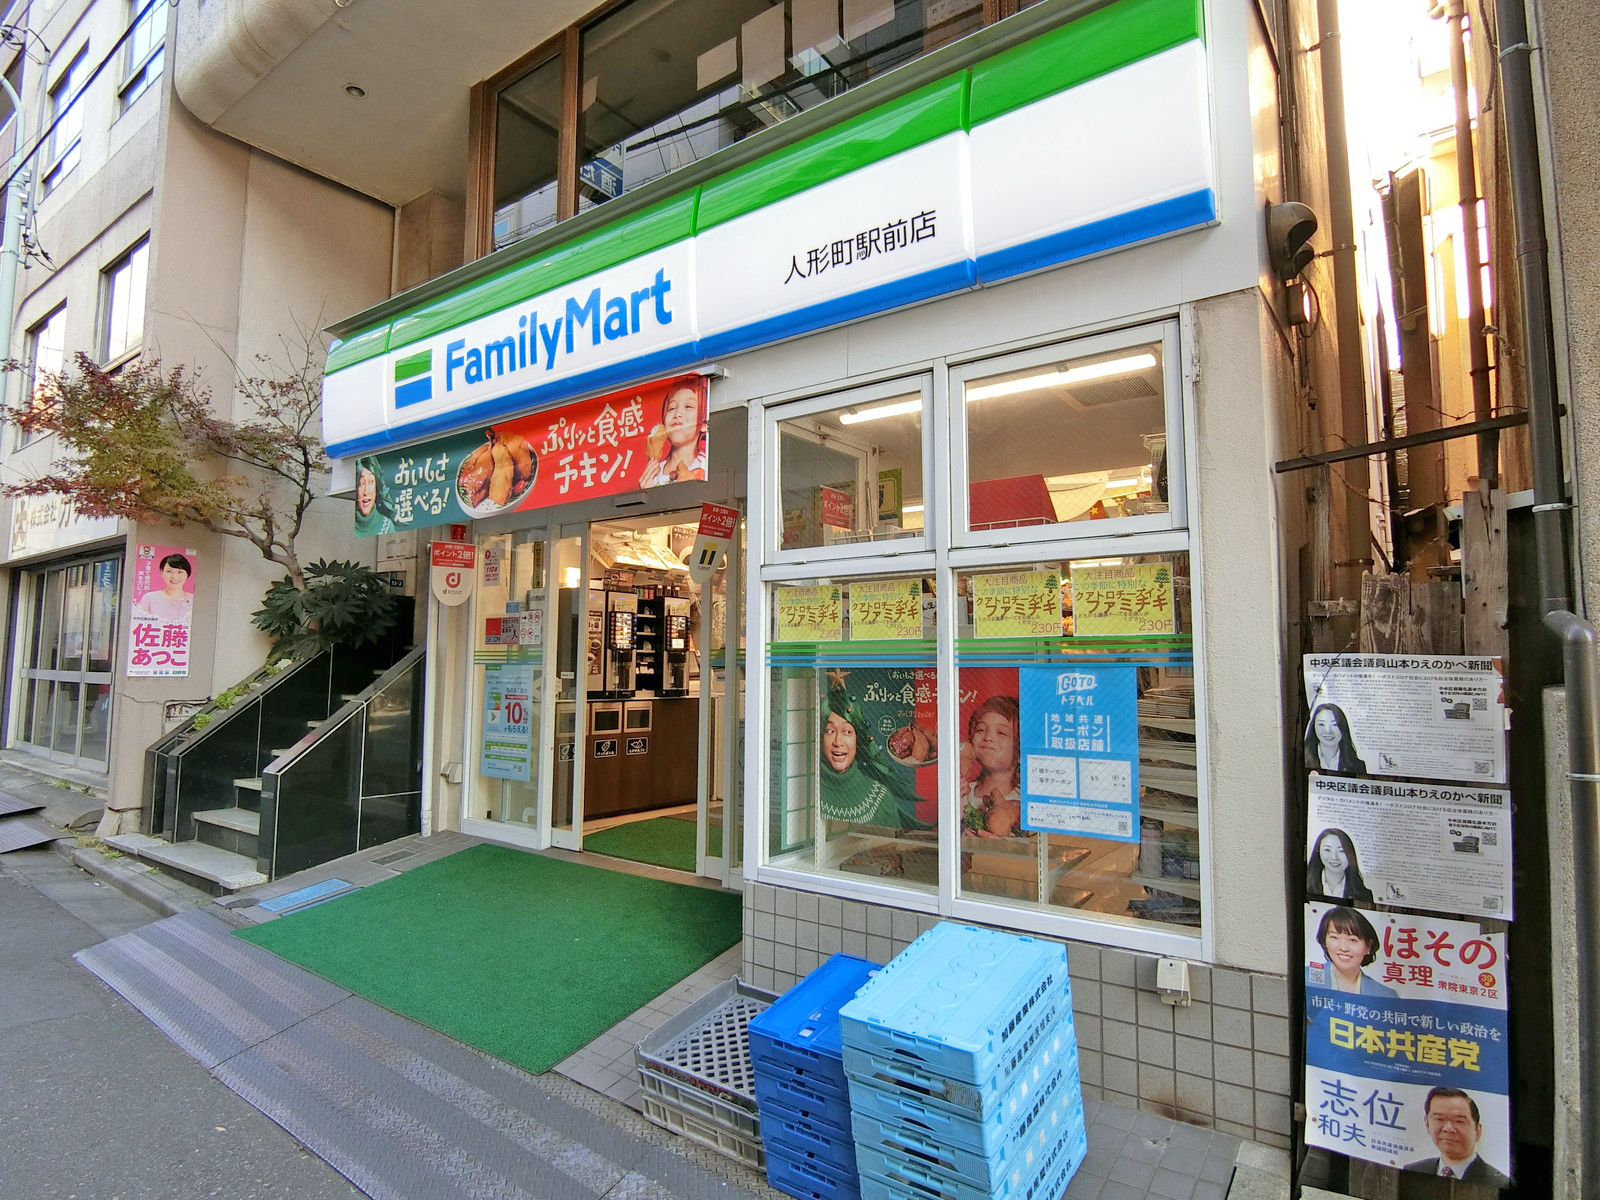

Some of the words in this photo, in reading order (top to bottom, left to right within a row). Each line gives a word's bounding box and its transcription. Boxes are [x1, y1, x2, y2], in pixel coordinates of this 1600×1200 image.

[784, 210, 937, 284] 人形町駅前店
[445, 268, 674, 392] FamilyMart
[395, 453, 450, 487] おいしさ
[395, 487, 450, 524] 選べる!
[434, 550, 474, 560] ポイント2倍!
[976, 593, 1055, 606] クアトロチーズイン
[1075, 587, 1166, 601] クアトロチーズイン
[780, 604, 838, 614] クアトロチーズイン
[852, 599, 918, 611] クアトロチーズイン
[986, 601, 1056, 617] ファミチキ
[1087, 597, 1168, 613] ファミチキ
[787, 610, 838, 624] ファミチキ
[860, 606, 918, 622] ファミチキ
[897, 627, 921, 636] 230円
[1031, 622, 1061, 633] 230円
[1138, 619, 1173, 631] 230円
[132, 623, 189, 648] 佐藤
[820, 629, 841, 639] 230円
[131, 648, 186, 666] あつこ
[1310, 658, 1493, 671] 中央区議会議員山本りえのかべ新聞
[863, 682, 978, 707] ぷりッと食感ン!
[1061, 695, 1094, 706] トラベル
[1050, 713, 1104, 725] 地域共通
[1051, 724, 1104, 737] クーポン
[1051, 737, 1105, 752] 取扱店舗
[1316, 780, 1503, 805] 中央区議会議員山本りえのかべ新聞
[1383, 925, 1497, 970] ほその
[1382, 961, 1434, 988] 真理
[1329, 1017, 1480, 1072] 日本共産党
[1320, 1079, 1406, 1131] 志位
[1318, 1114, 1366, 1147] 和夫
